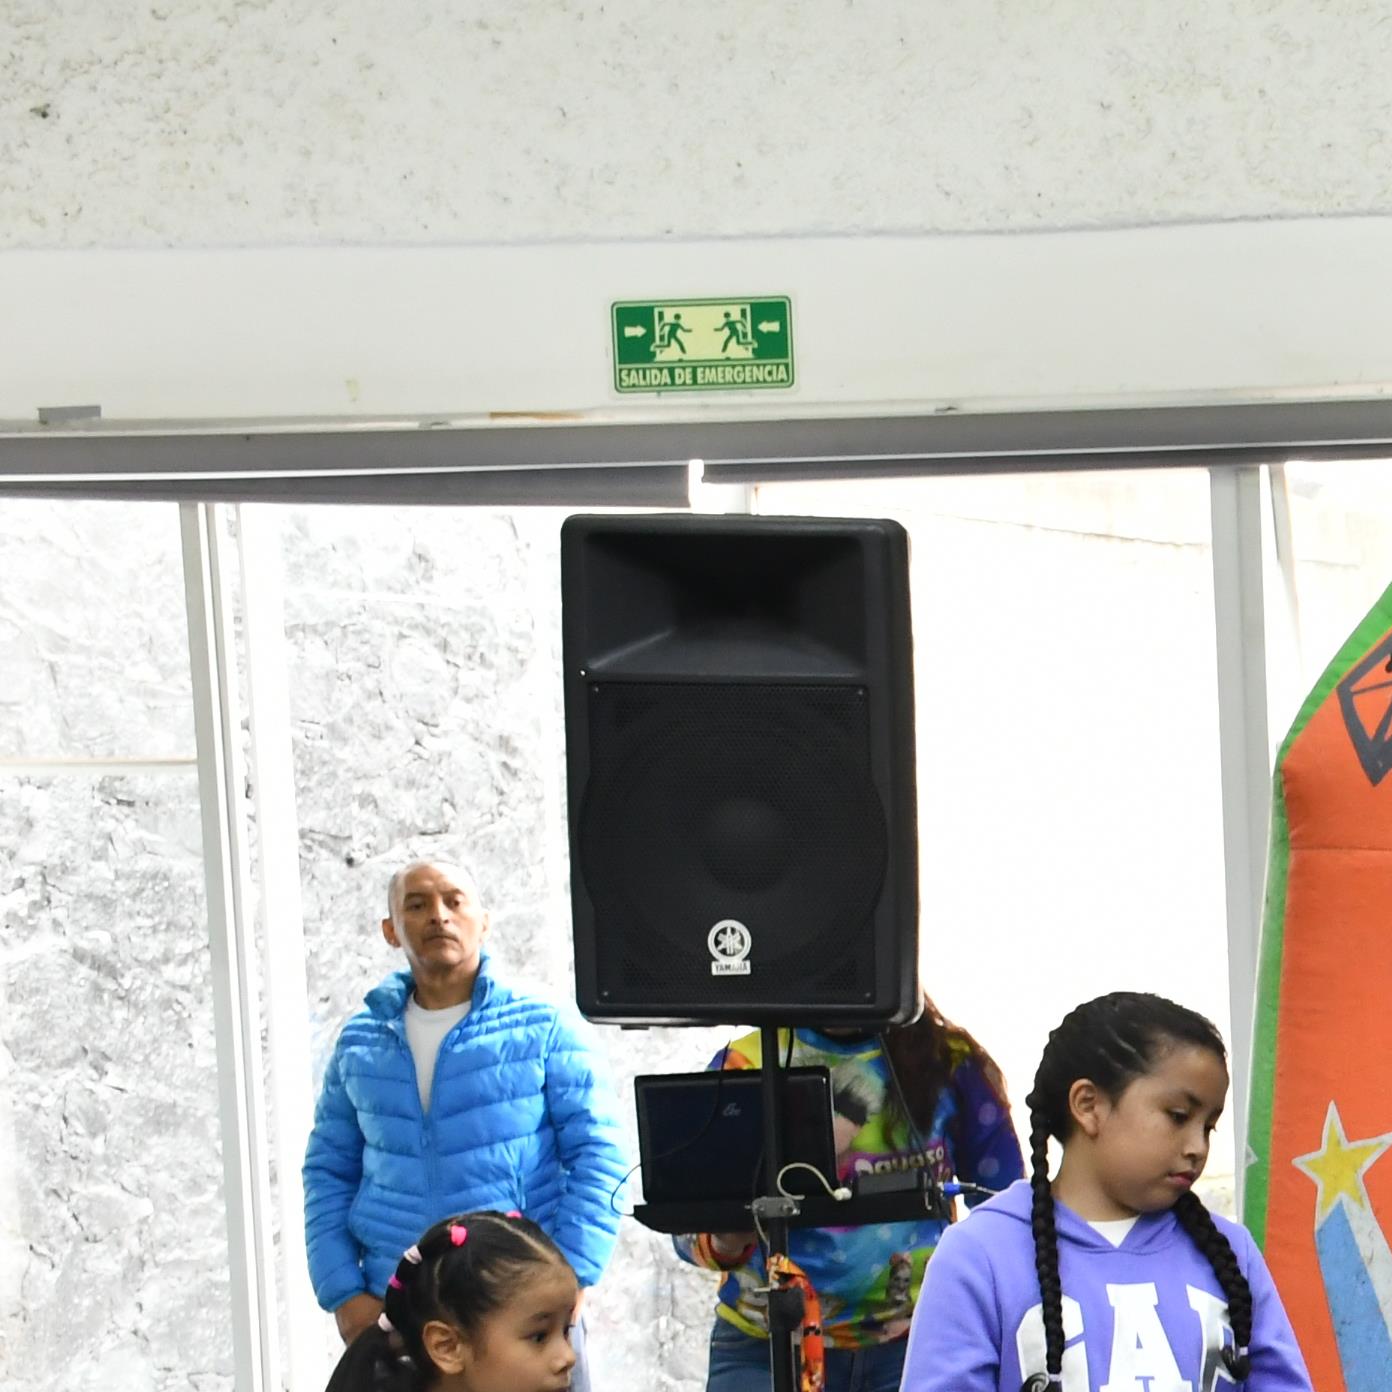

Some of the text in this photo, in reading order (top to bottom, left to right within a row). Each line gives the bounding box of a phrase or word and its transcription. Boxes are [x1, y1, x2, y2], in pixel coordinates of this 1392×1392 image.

[620, 363, 789, 387] SALIDA DE EMERGENCIA
